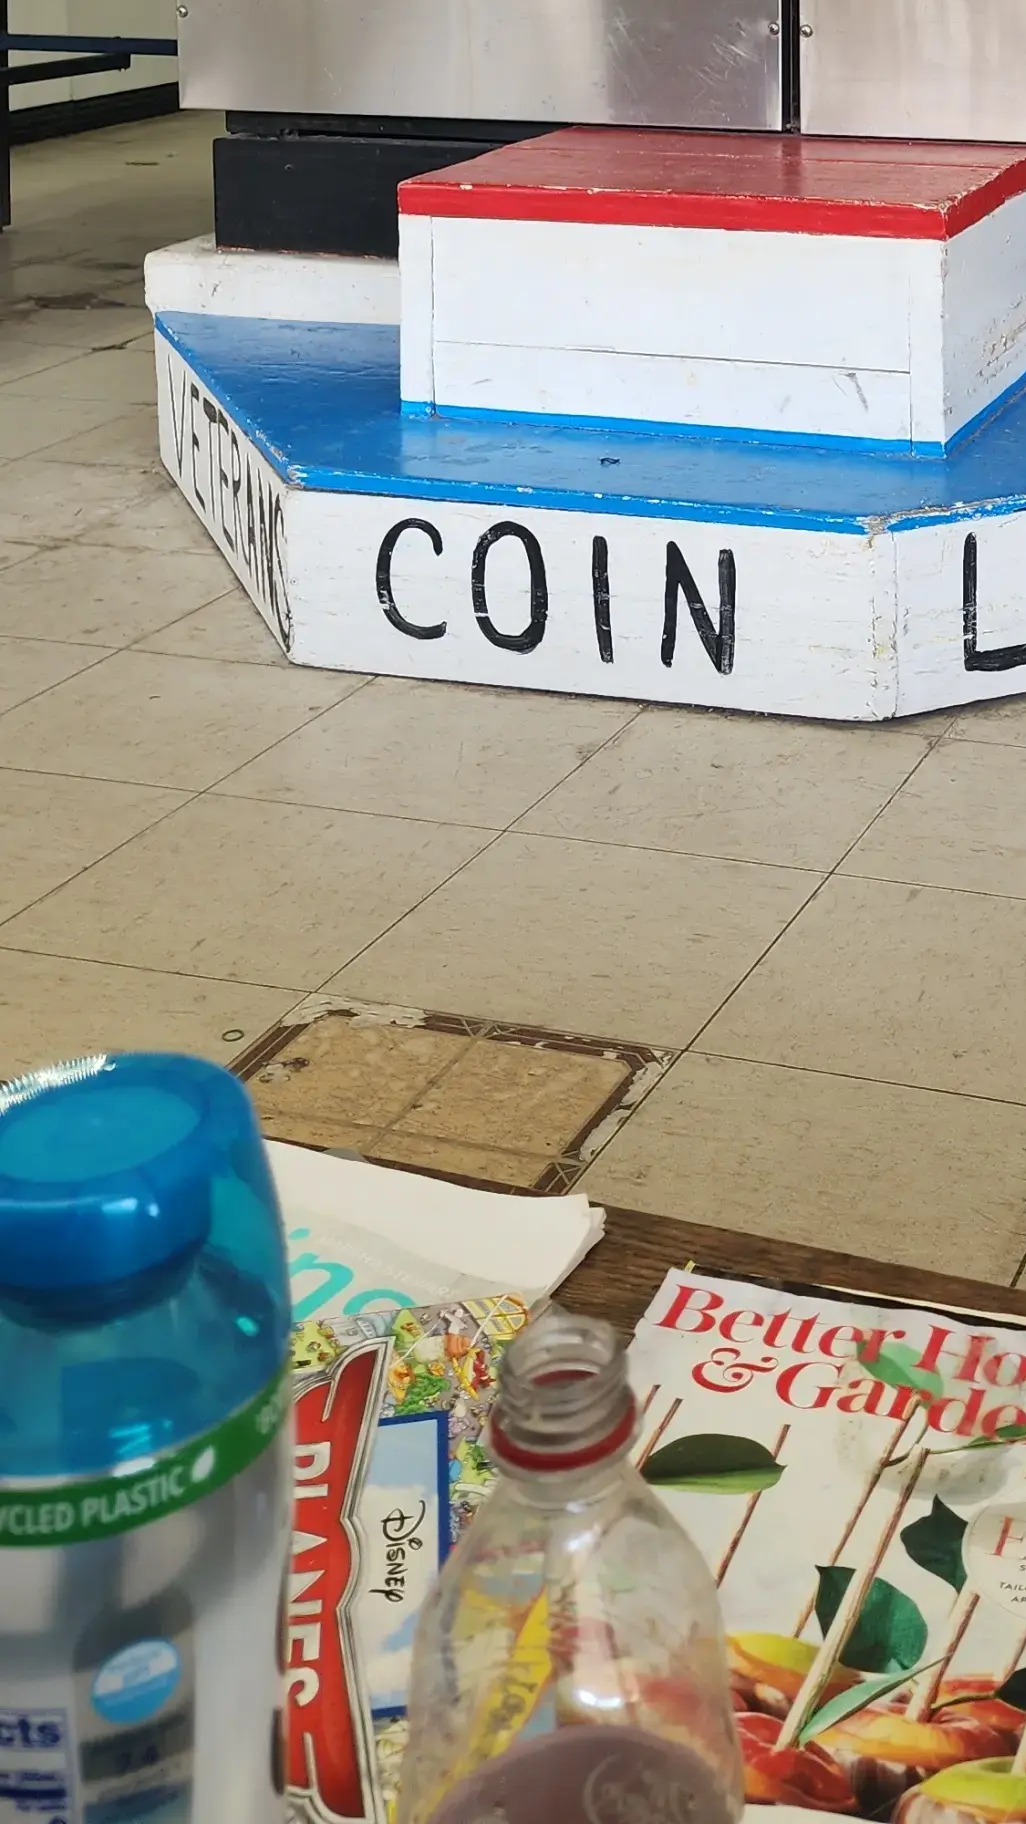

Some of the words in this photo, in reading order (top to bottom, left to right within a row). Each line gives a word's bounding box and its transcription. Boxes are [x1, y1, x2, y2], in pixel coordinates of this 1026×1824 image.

[165, 353, 293, 653] VETERANS
[375, 517, 738, 675] COIN
[655, 1284, 906, 1363] Better
[691, 1347, 779, 1393] &
[80, 1465, 187, 1528] PLASTIC
